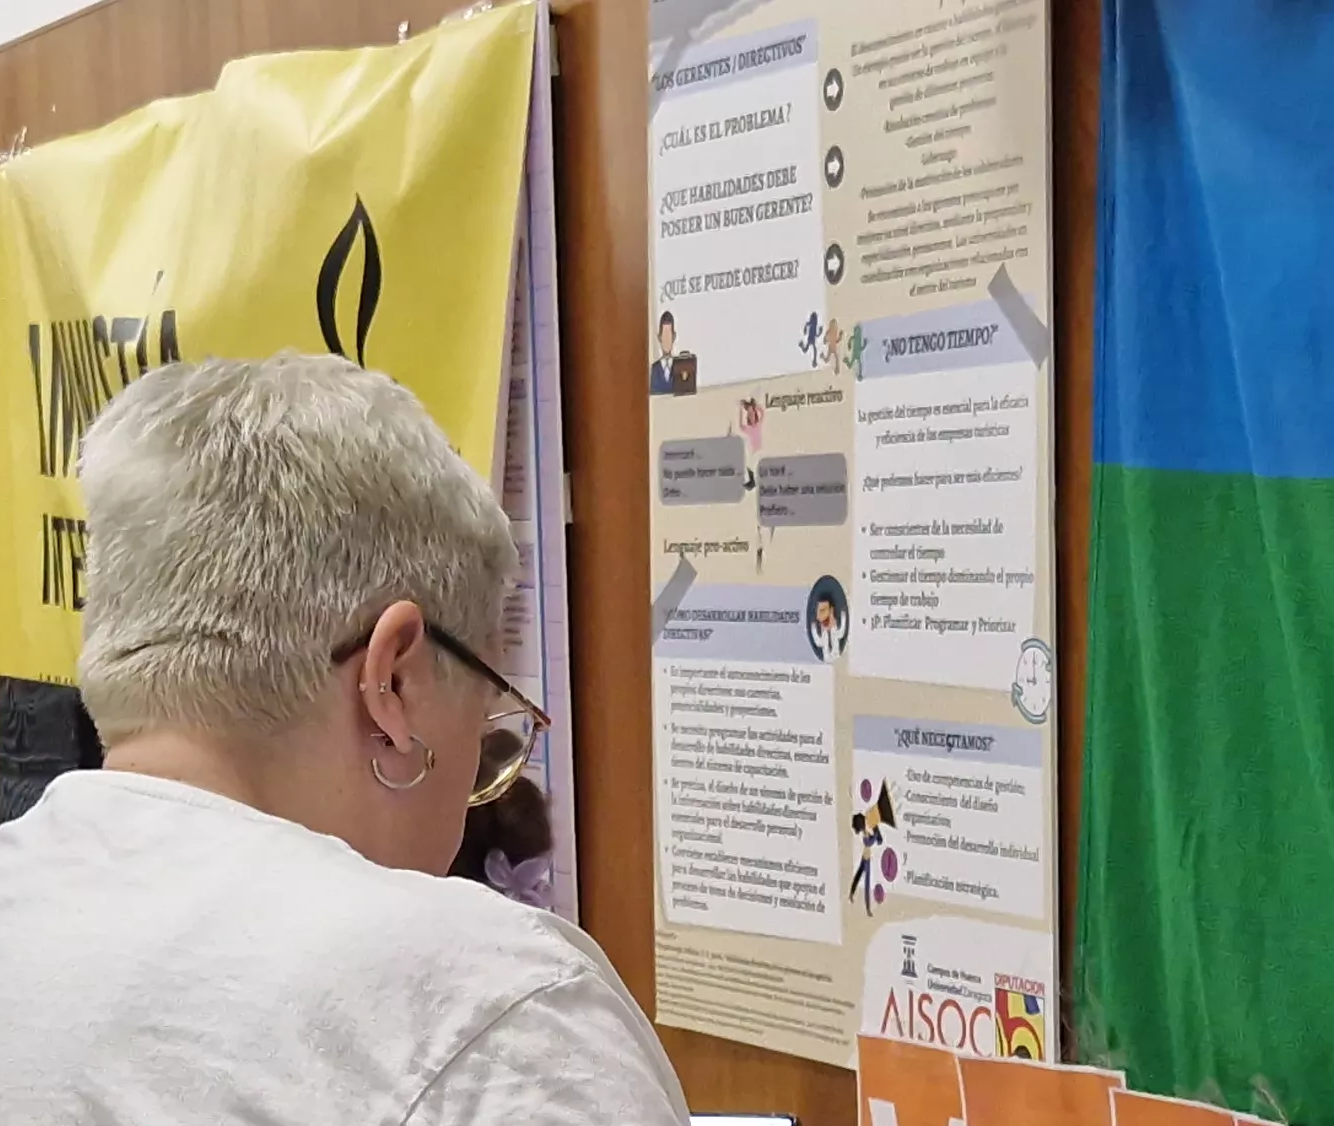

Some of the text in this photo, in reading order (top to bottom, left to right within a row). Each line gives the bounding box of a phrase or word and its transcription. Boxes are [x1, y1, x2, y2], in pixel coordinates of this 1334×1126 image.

[676, 57, 731, 87] GERENTES
[694, 124, 707, 143] ES
[709, 122, 722, 140] EL
[689, 173, 764, 204] HABILIDADES
[766, 165, 797, 190] DEBE
[660, 192, 813, 239] POSEER UN BUEN GERENTE?
[689, 275, 702, 294] SE
[704, 269, 741, 292] PUEDE
[743, 258, 799, 287] OFRECER?
[908, 331, 946, 354] TENGO
[765, 385, 843, 411] Lenguaje reactivo
[664, 536, 702, 558] Lenguaje
